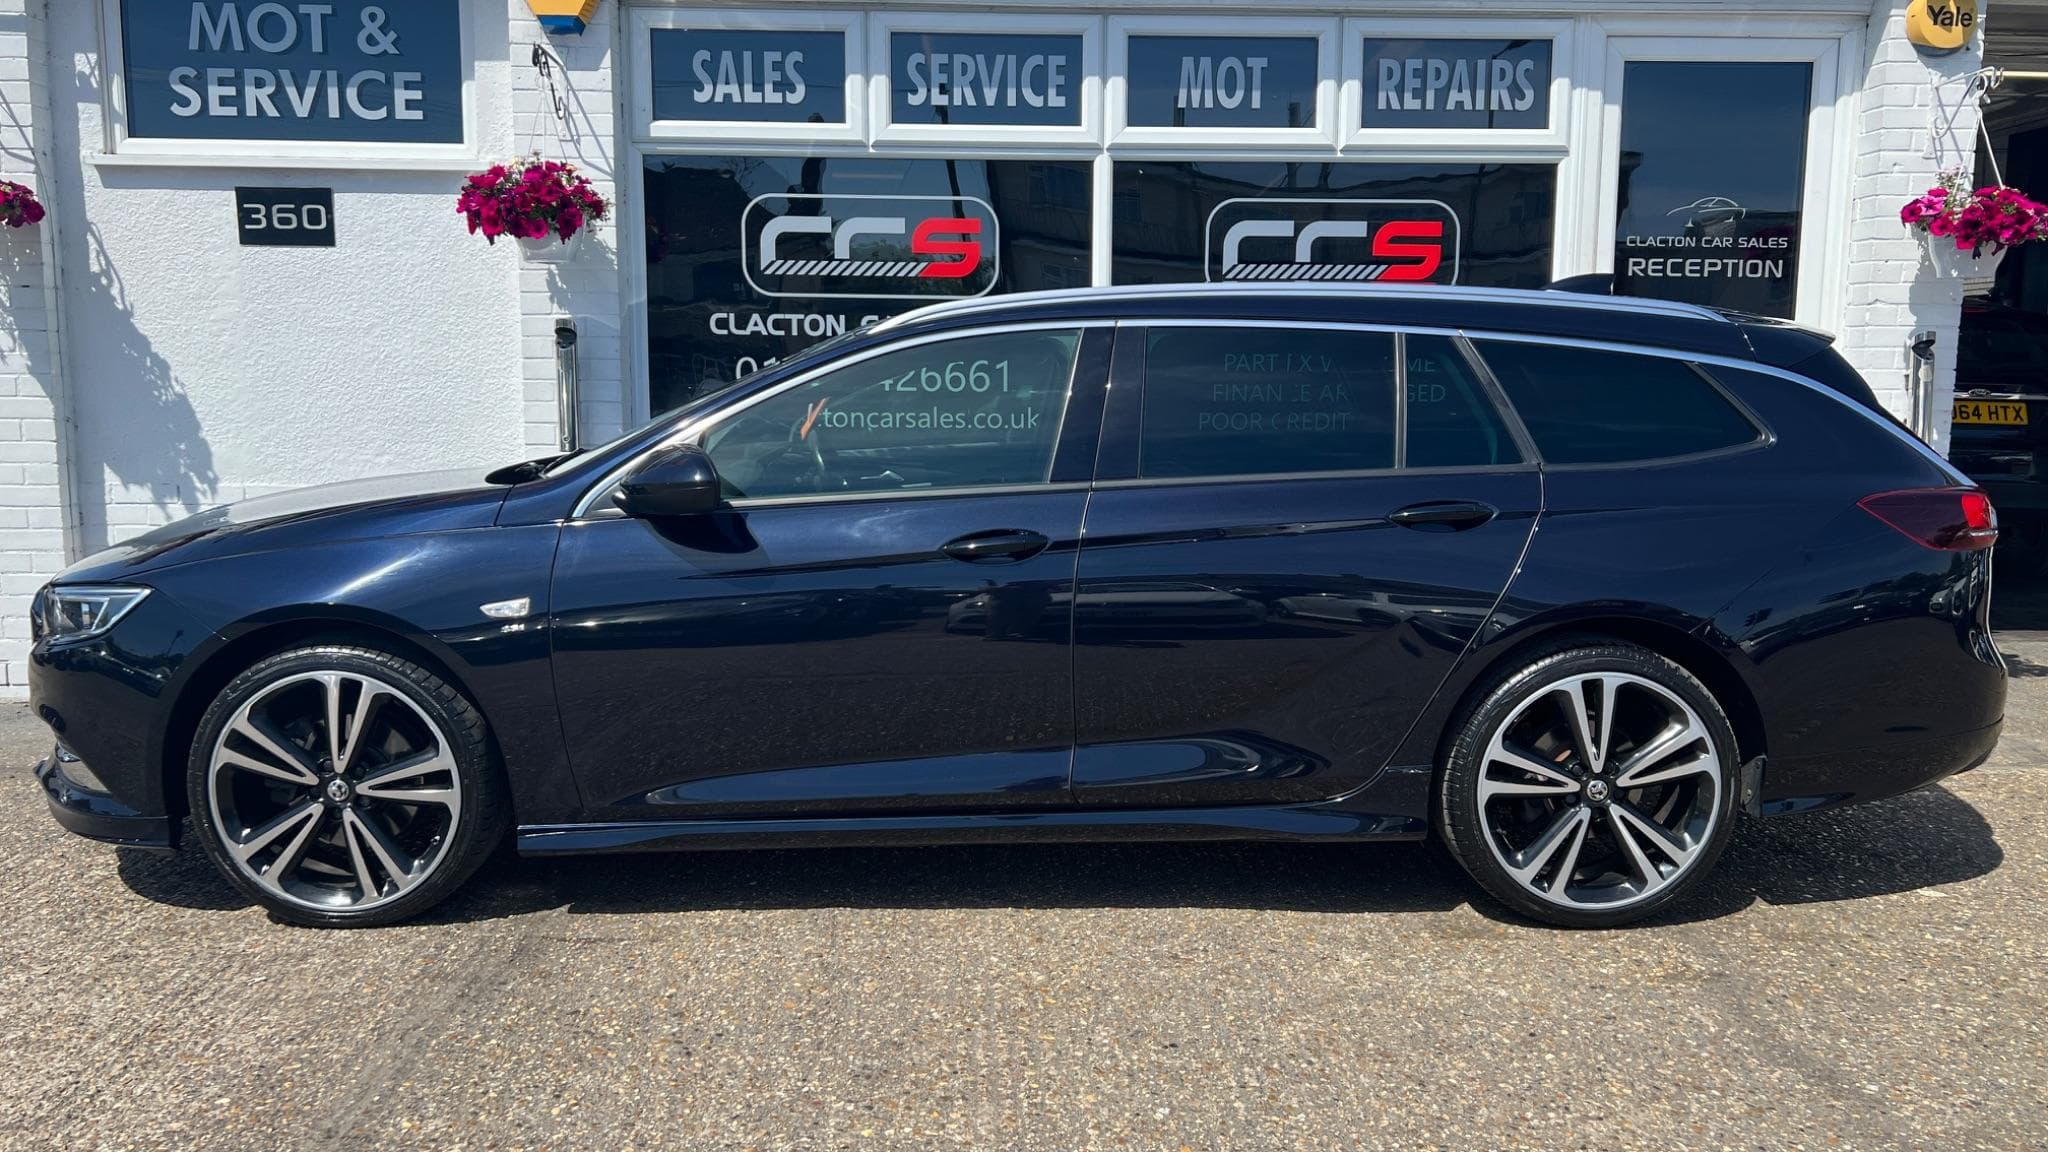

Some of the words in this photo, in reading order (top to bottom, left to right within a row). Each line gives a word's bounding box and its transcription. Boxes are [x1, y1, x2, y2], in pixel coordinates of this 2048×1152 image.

[188, 2, 334, 53] MOT
[357, 5, 400, 55] &
[1928, 5, 1973, 27] Yale
[692, 49, 806, 105] SALES
[907, 52, 1067, 108] SERVICE
[1177, 56, 1268, 110] MOT
[1377, 58, 1535, 111] REPAIRS
[168, 66, 424, 120] SERVICE
[243, 203, 327, 230] 360
[1626, 236, 1696, 247] CLACTON
[1701, 237, 1733, 248] CAR
[1738, 237, 1788, 249] SALES
[1627, 258, 1783, 278] RECEPTION
[709, 313, 845, 336] CLACTON
[1224, 353, 1279, 372] PART
[1199, 412, 1263, 431] POOR
[1987, 405, 2025, 422] HTX
